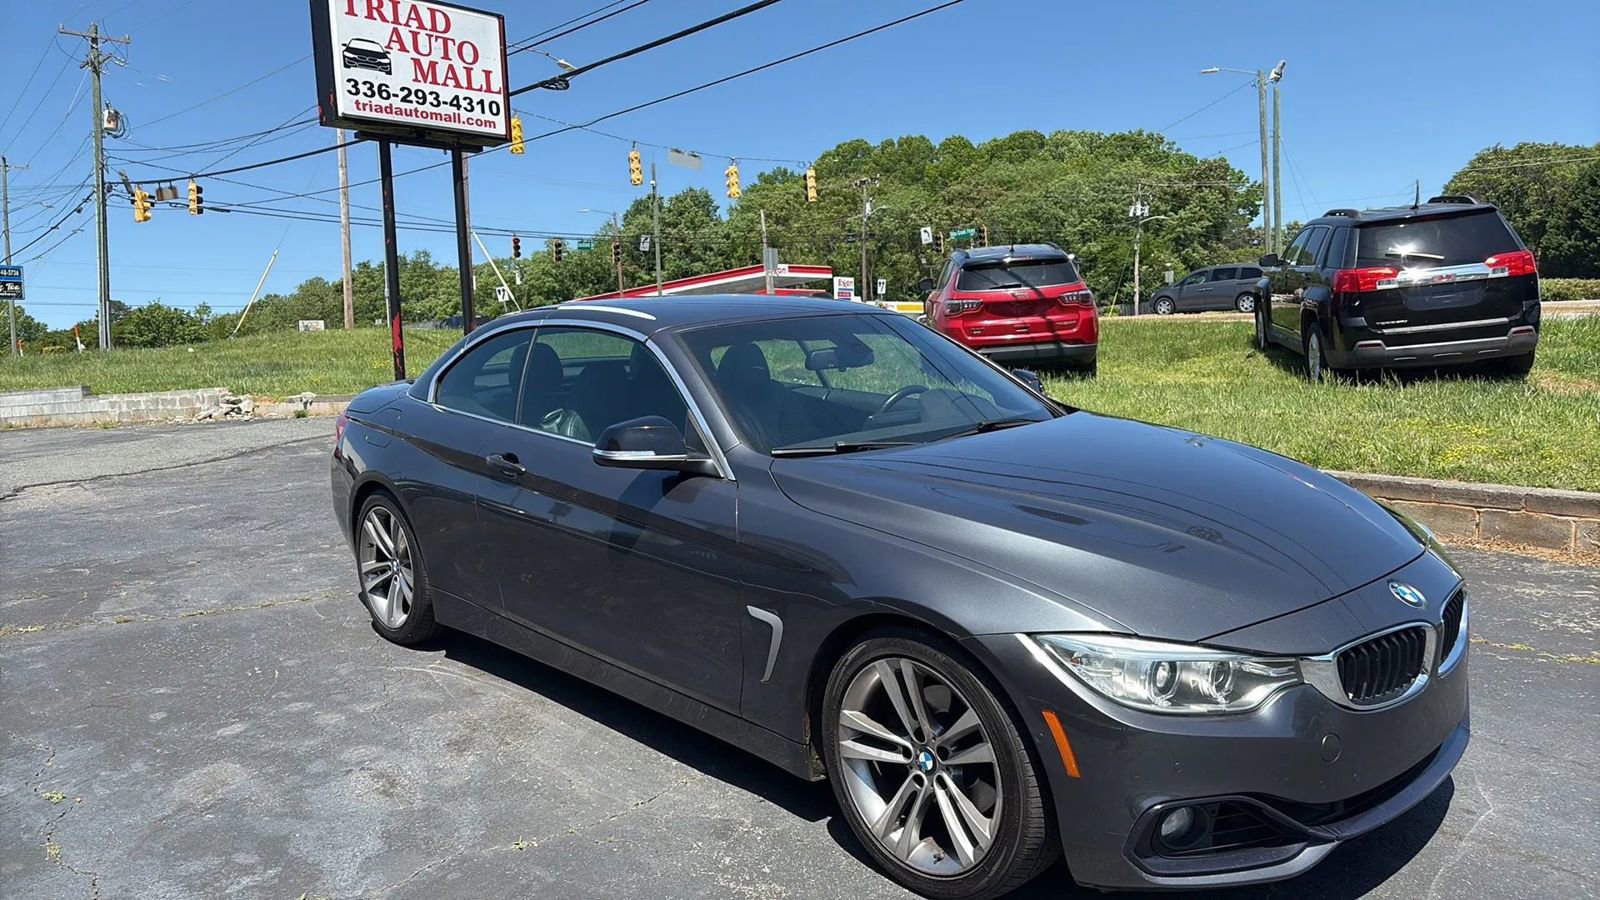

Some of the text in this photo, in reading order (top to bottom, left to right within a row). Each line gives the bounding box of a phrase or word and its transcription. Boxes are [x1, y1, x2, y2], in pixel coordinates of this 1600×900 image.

[344, 0, 451, 34] TRIAD
[385, 27, 480, 66] AUTO
[411, 58, 502, 95] MALL
[346, 78, 501, 117] 336-293-4310
[354, 100, 497, 129] triadautomall.com
